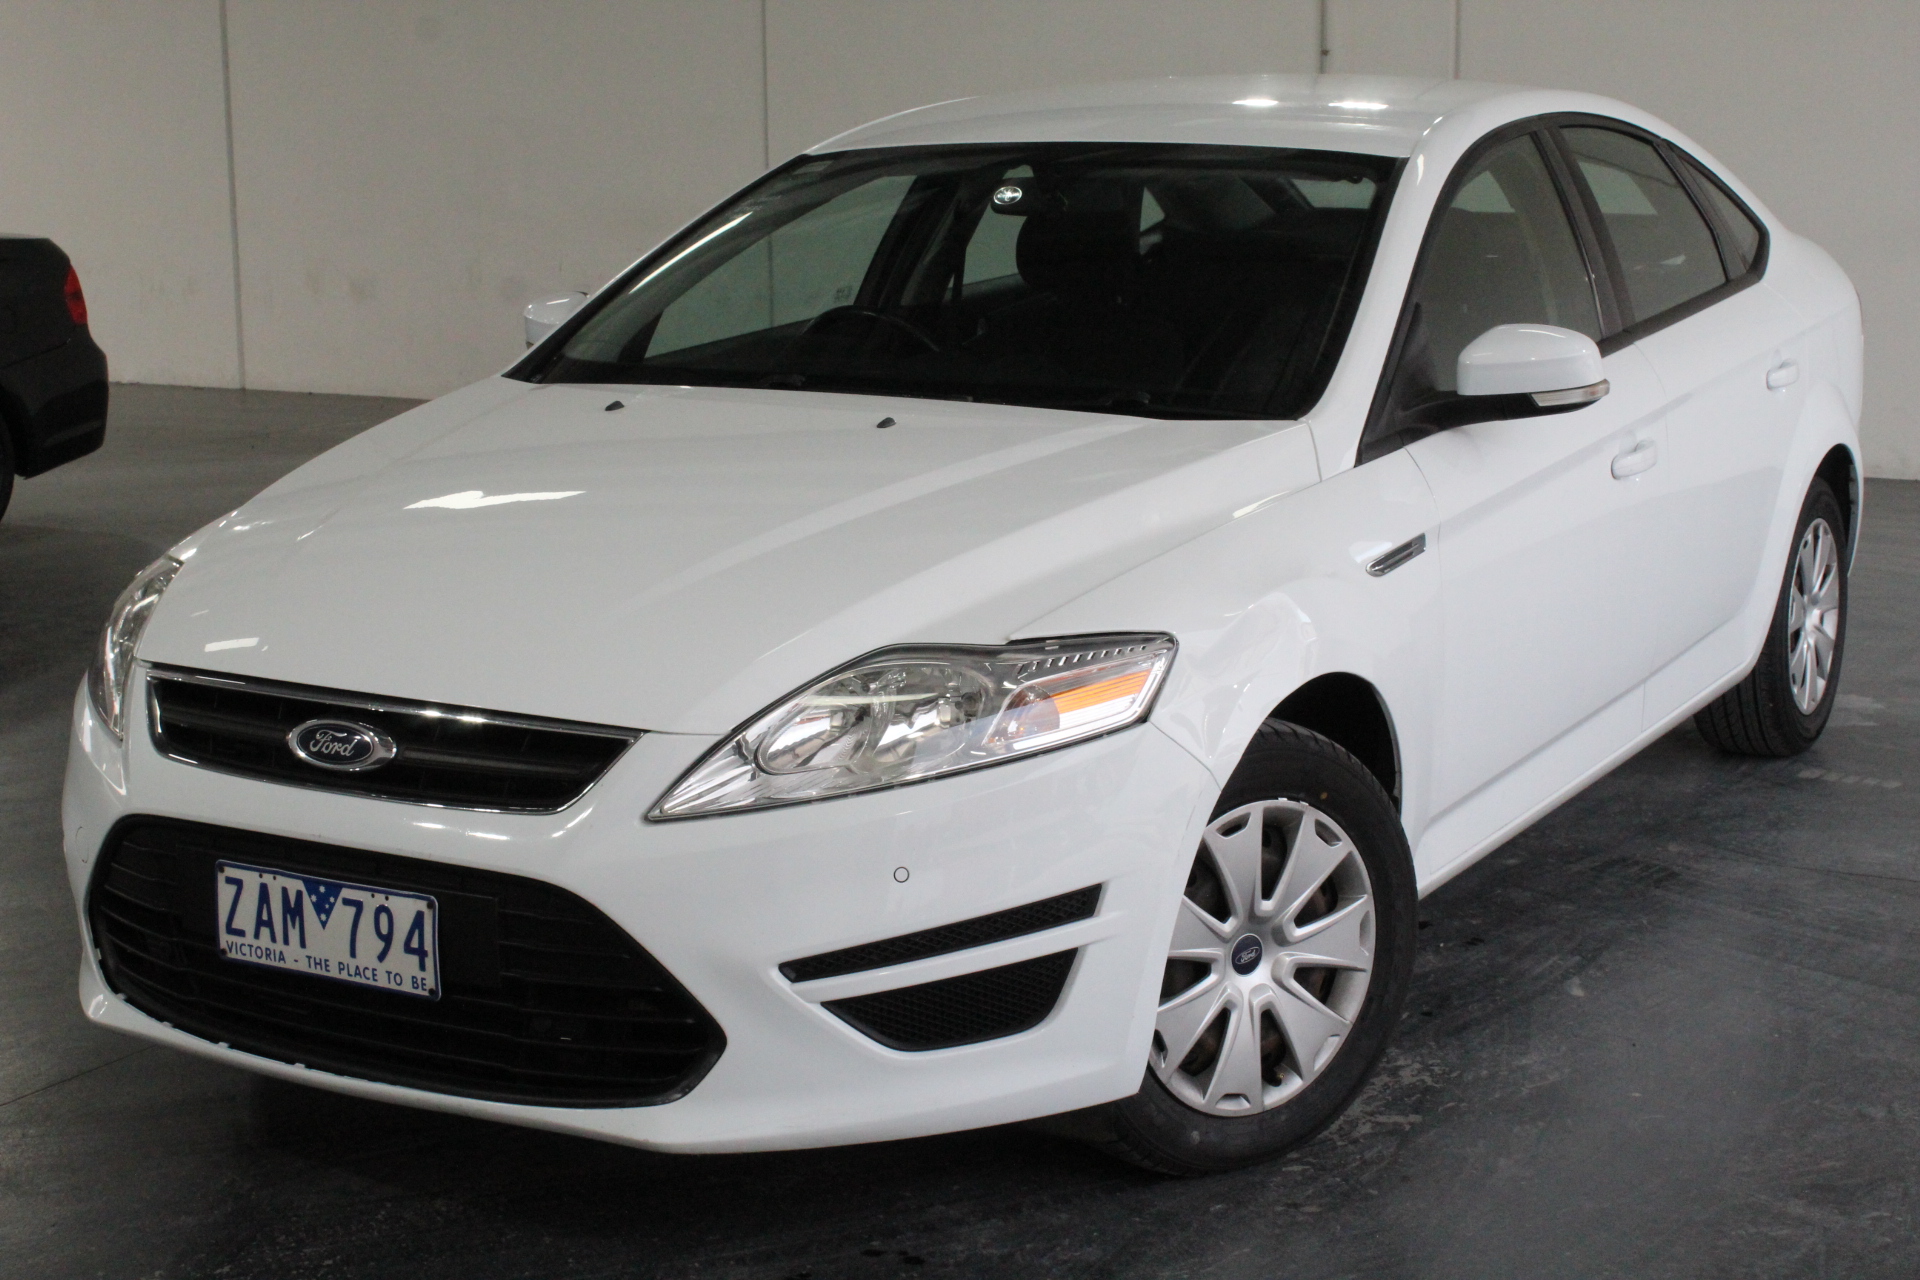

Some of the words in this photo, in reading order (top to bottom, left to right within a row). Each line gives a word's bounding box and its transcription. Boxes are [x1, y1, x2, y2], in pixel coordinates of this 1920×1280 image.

[309, 729, 358, 757] Ford
[224, 875, 307, 949] ZAM
[341, 896, 429, 972] 794
[225, 940, 287, 964] VICTORIA
[305, 955, 331, 973] THE
[337, 961, 379, 982] PLACE
[385, 970, 403, 987] TO
[411, 975, 428, 991] BE
